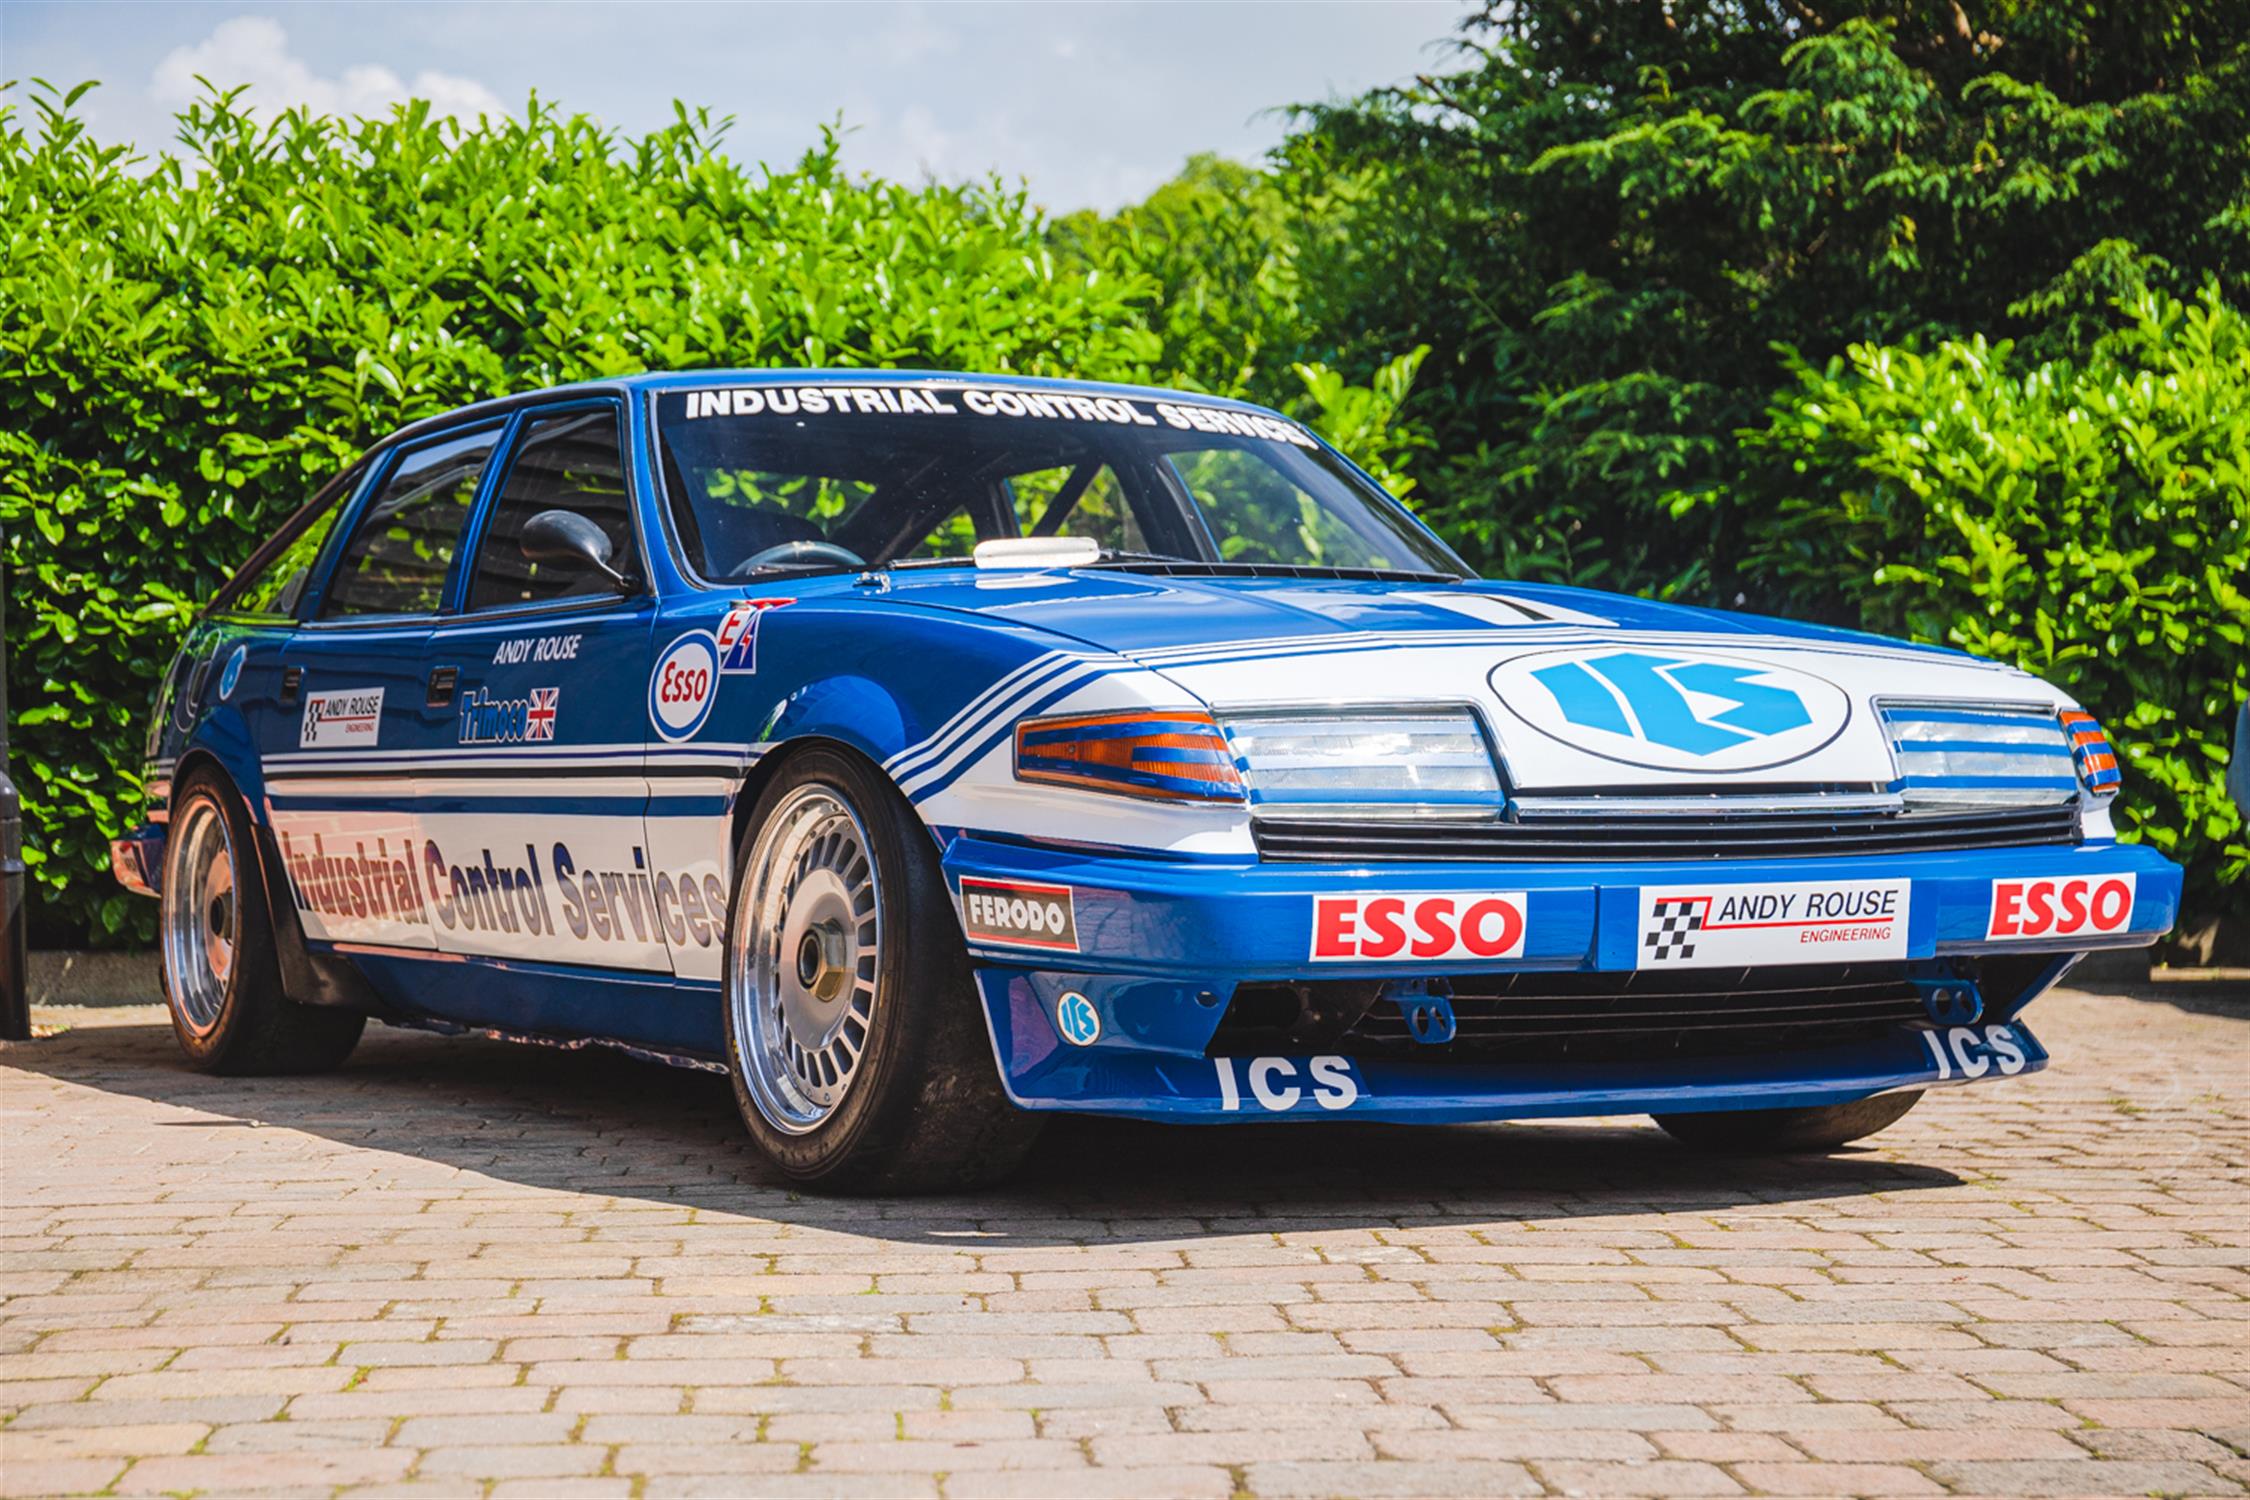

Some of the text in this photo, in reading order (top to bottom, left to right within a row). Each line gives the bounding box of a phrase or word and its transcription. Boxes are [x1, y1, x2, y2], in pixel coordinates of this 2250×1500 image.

[686, 387, 958, 420] INDUSTRIAL
[962, 390, 1158, 426] CONTROL
[492, 634, 583, 665] ANDY ROUSE
[324, 695, 381, 717] ANDY ROUSE
[281, 831, 727, 949] Industrial Control Services
[1718, 889, 1899, 922] ANDY ROUSE
[1989, 878, 2133, 937] ESSO
[968, 893, 1066, 936] FERODO
[1314, 897, 1524, 958] ESSO
[1799, 926, 1892, 943] ENGINEERING
[1922, 1023, 2027, 1081] ICS
[1214, 1055, 1359, 1112] ICS
